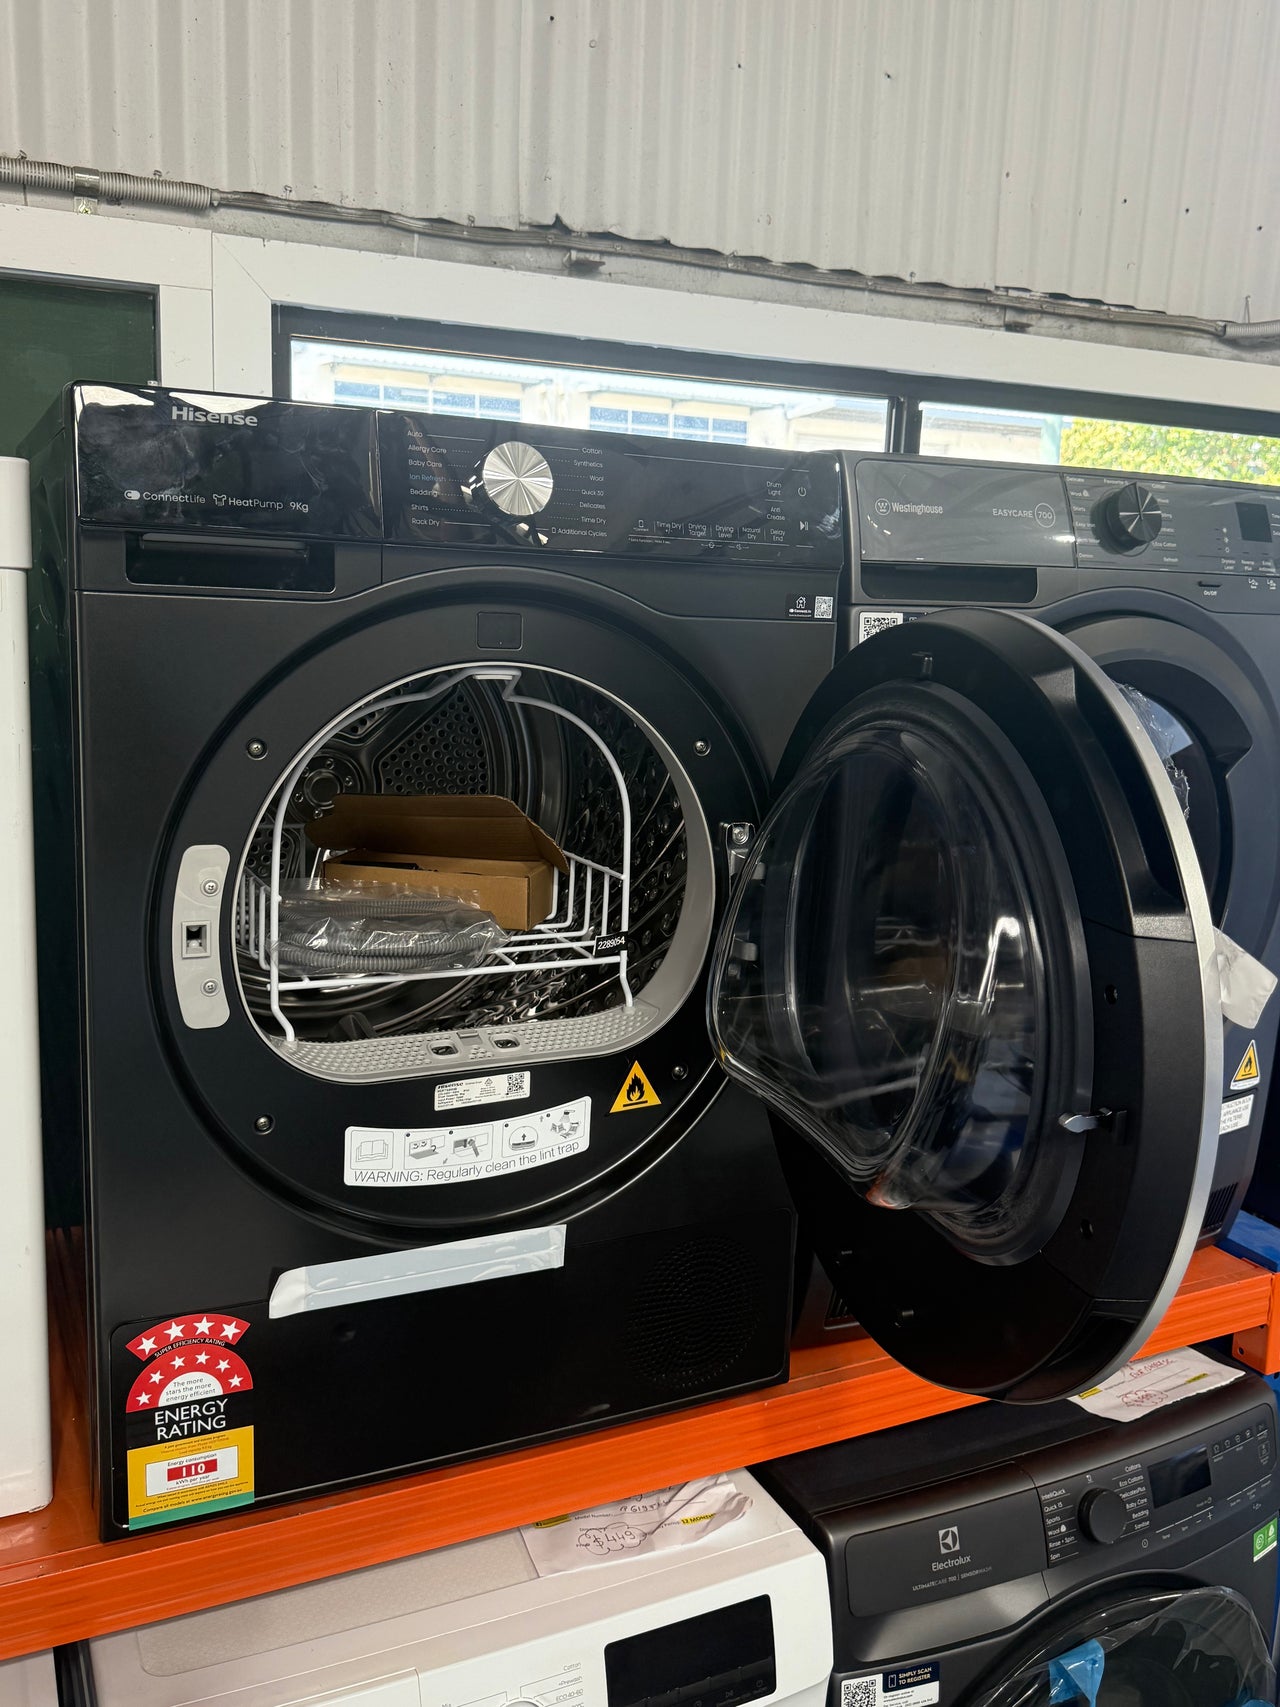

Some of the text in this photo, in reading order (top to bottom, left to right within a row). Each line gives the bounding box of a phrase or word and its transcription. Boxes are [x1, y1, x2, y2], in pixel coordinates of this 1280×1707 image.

[172, 406, 258, 427] Hisense
[407, 430, 423, 438] Auto
[408, 444, 430, 455] Allergy
[582, 447, 603, 455] Cotton
[408, 459, 425, 468] Baby
[573, 459, 604, 469] Synthetics
[409, 473, 446, 482] Ion Refresh
[410, 488, 438, 497] Bedding
[581, 489, 596, 497] Quick
[767, 488, 782, 496] Light
[143, 491, 309, 513] ConnectLife HeatPump 9Kg
[579, 502, 606, 510] Delicates
[411, 504, 429, 512] Shirts
[891, 502, 943, 515] Westinghouse
[992, 507, 1053, 520] EASYCARE 700
[412, 518, 440, 527] Rack Dry
[595, 517, 607, 525] Dry
[657, 521, 671, 529] Time
[688, 523, 707, 532] Drying
[715, 525, 734, 533] Drying
[557, 528, 608, 538] Additional Cycles
[689, 530, 706, 538] Target
[770, 529, 785, 537] Delay
[354, 1141, 580, 1182] WARNING: Regularly clean the lint trap
[154, 1338, 226, 1358] SUPER EFFICIENCY RATING
[165, 1388, 182, 1396] stars
[165, 1388, 216, 1403] energy efficient
[154, 1398, 229, 1426] ENERGY
[156, 1415, 227, 1441] RATING
[167, 1453, 217, 1467] Energy consumption
[182, 1463, 206, 1477] 110
[1124, 1463, 1142, 1472] Cottons
[1127, 1475, 1144, 1484] Cottons
[1041, 1488, 1066, 1500] IntelliQuick
[1044, 1504, 1057, 1513] Quick
[1126, 1502, 1137, 1510] Baby
[1132, 1509, 1149, 1519] Bedding
[1046, 1516, 1061, 1525] Sports
[1047, 1528, 1060, 1536] Wool
[593, 1530, 637, 1550] $449
[1048, 1540, 1061, 1548] Rinse
[1064, 1536, 1075, 1544] Spin
[1050, 1552, 1061, 1560] Spin
[931, 1555, 972, 1572] Electrolux
[912, 1578, 947, 1591] ULTIMATECARE
[563, 1662, 582, 1671] Cotton
[898, 1667, 932, 1679] SIMPLY SCAN
[906, 1673, 931, 1684] REGISTER
[556, 1694, 568, 1702] ECO
